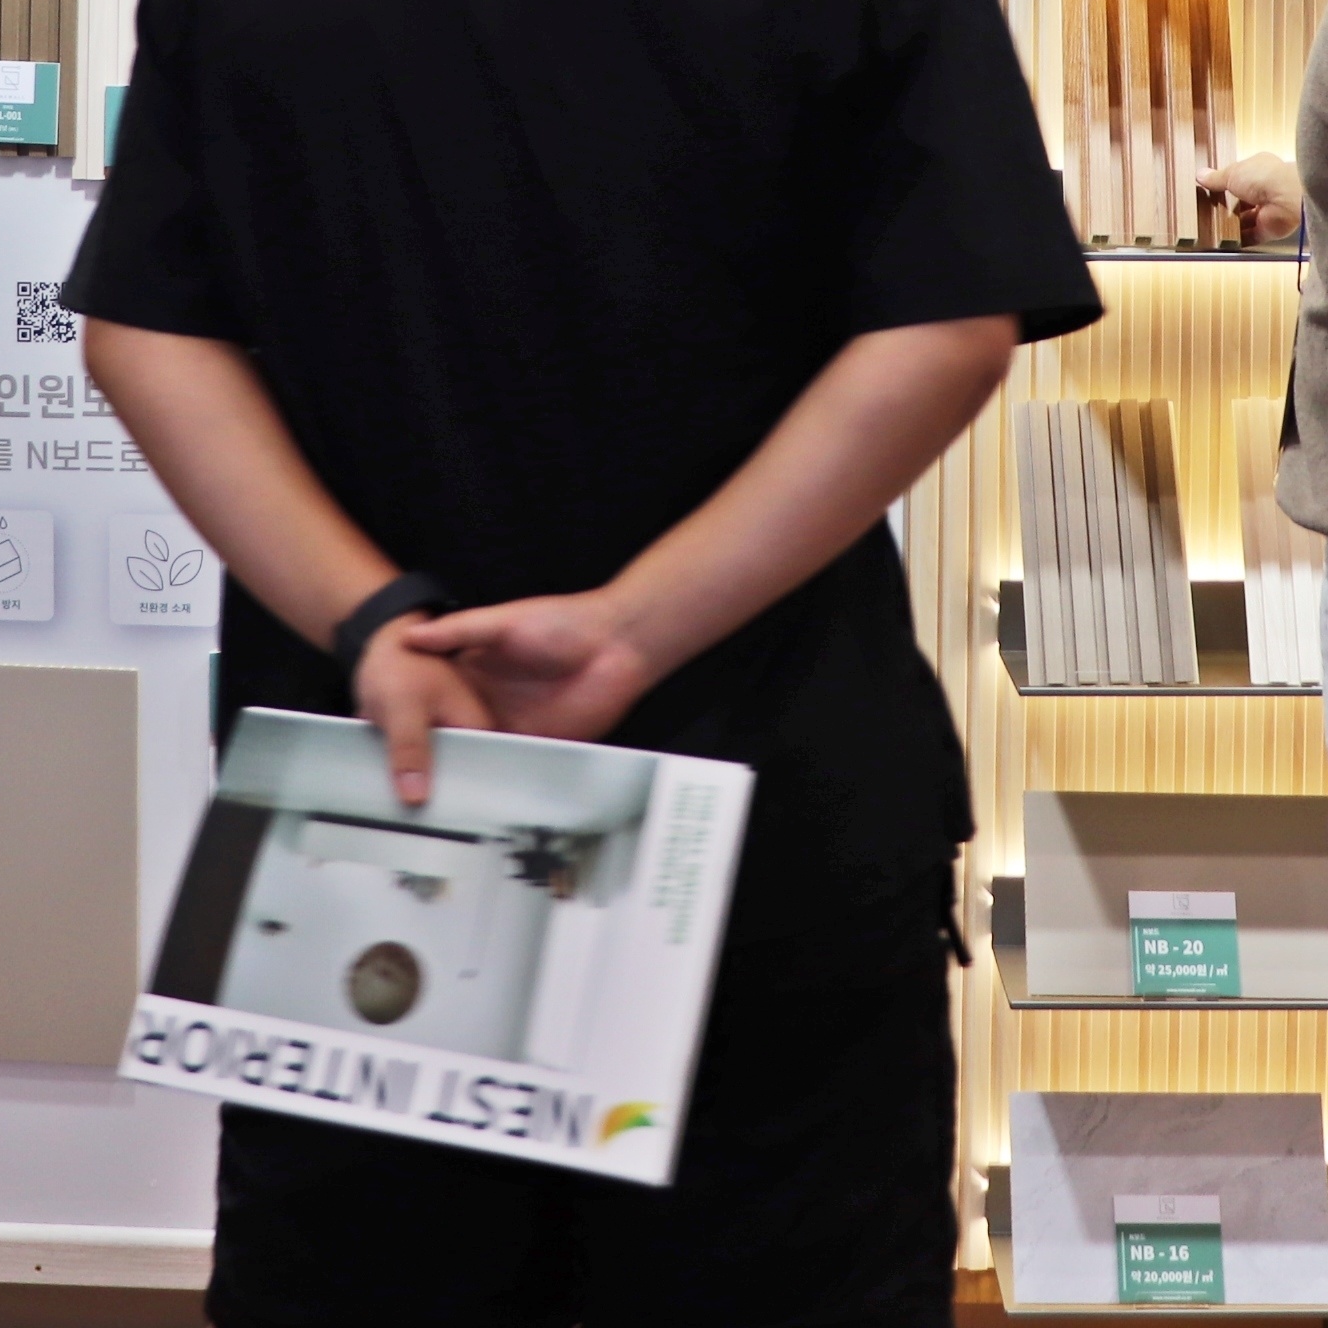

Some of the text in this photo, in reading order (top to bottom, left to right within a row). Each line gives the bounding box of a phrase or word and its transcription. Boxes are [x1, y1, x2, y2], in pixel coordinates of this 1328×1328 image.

[26, 437, 150, 473] N보드로
[2, 598, 21, 611] 방지
[138, 601, 192, 615] 친환경 소재
[1144, 939, 1169, 955] NB
[1182, 939, 1204, 955] 20
[1158, 963, 1207, 977] 25,000원
[130, 1008, 596, 1149] NEST INTERIOR
[1130, 1244, 1155, 1261] NB
[1169, 1244, 1190, 1262] 16
[1144, 1270, 1193, 1285] 20,000원
